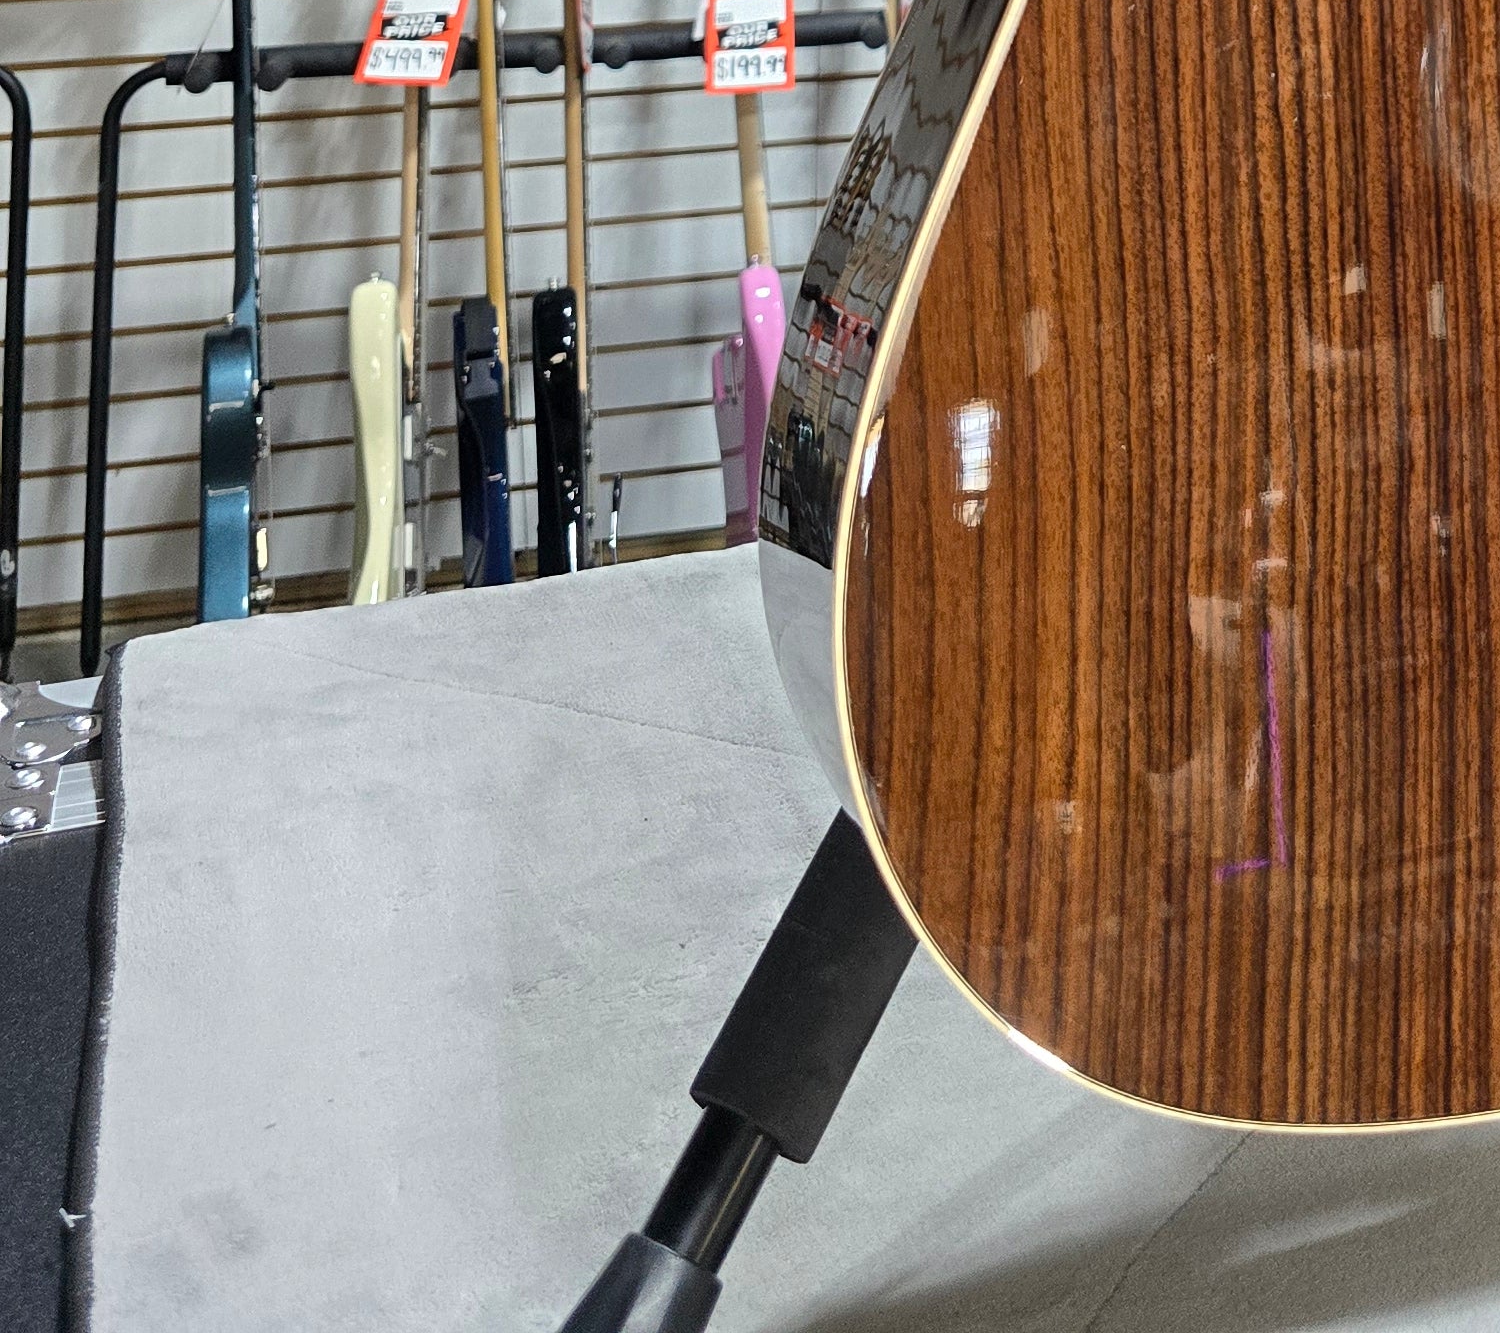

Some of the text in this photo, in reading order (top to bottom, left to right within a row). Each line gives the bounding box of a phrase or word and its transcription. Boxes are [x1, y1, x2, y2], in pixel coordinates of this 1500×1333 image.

[391, 13, 438, 26] OUR
[725, 20, 769, 36] OUR
[382, 21, 446, 39] PRICE
[721, 28, 778, 49] PRICE
